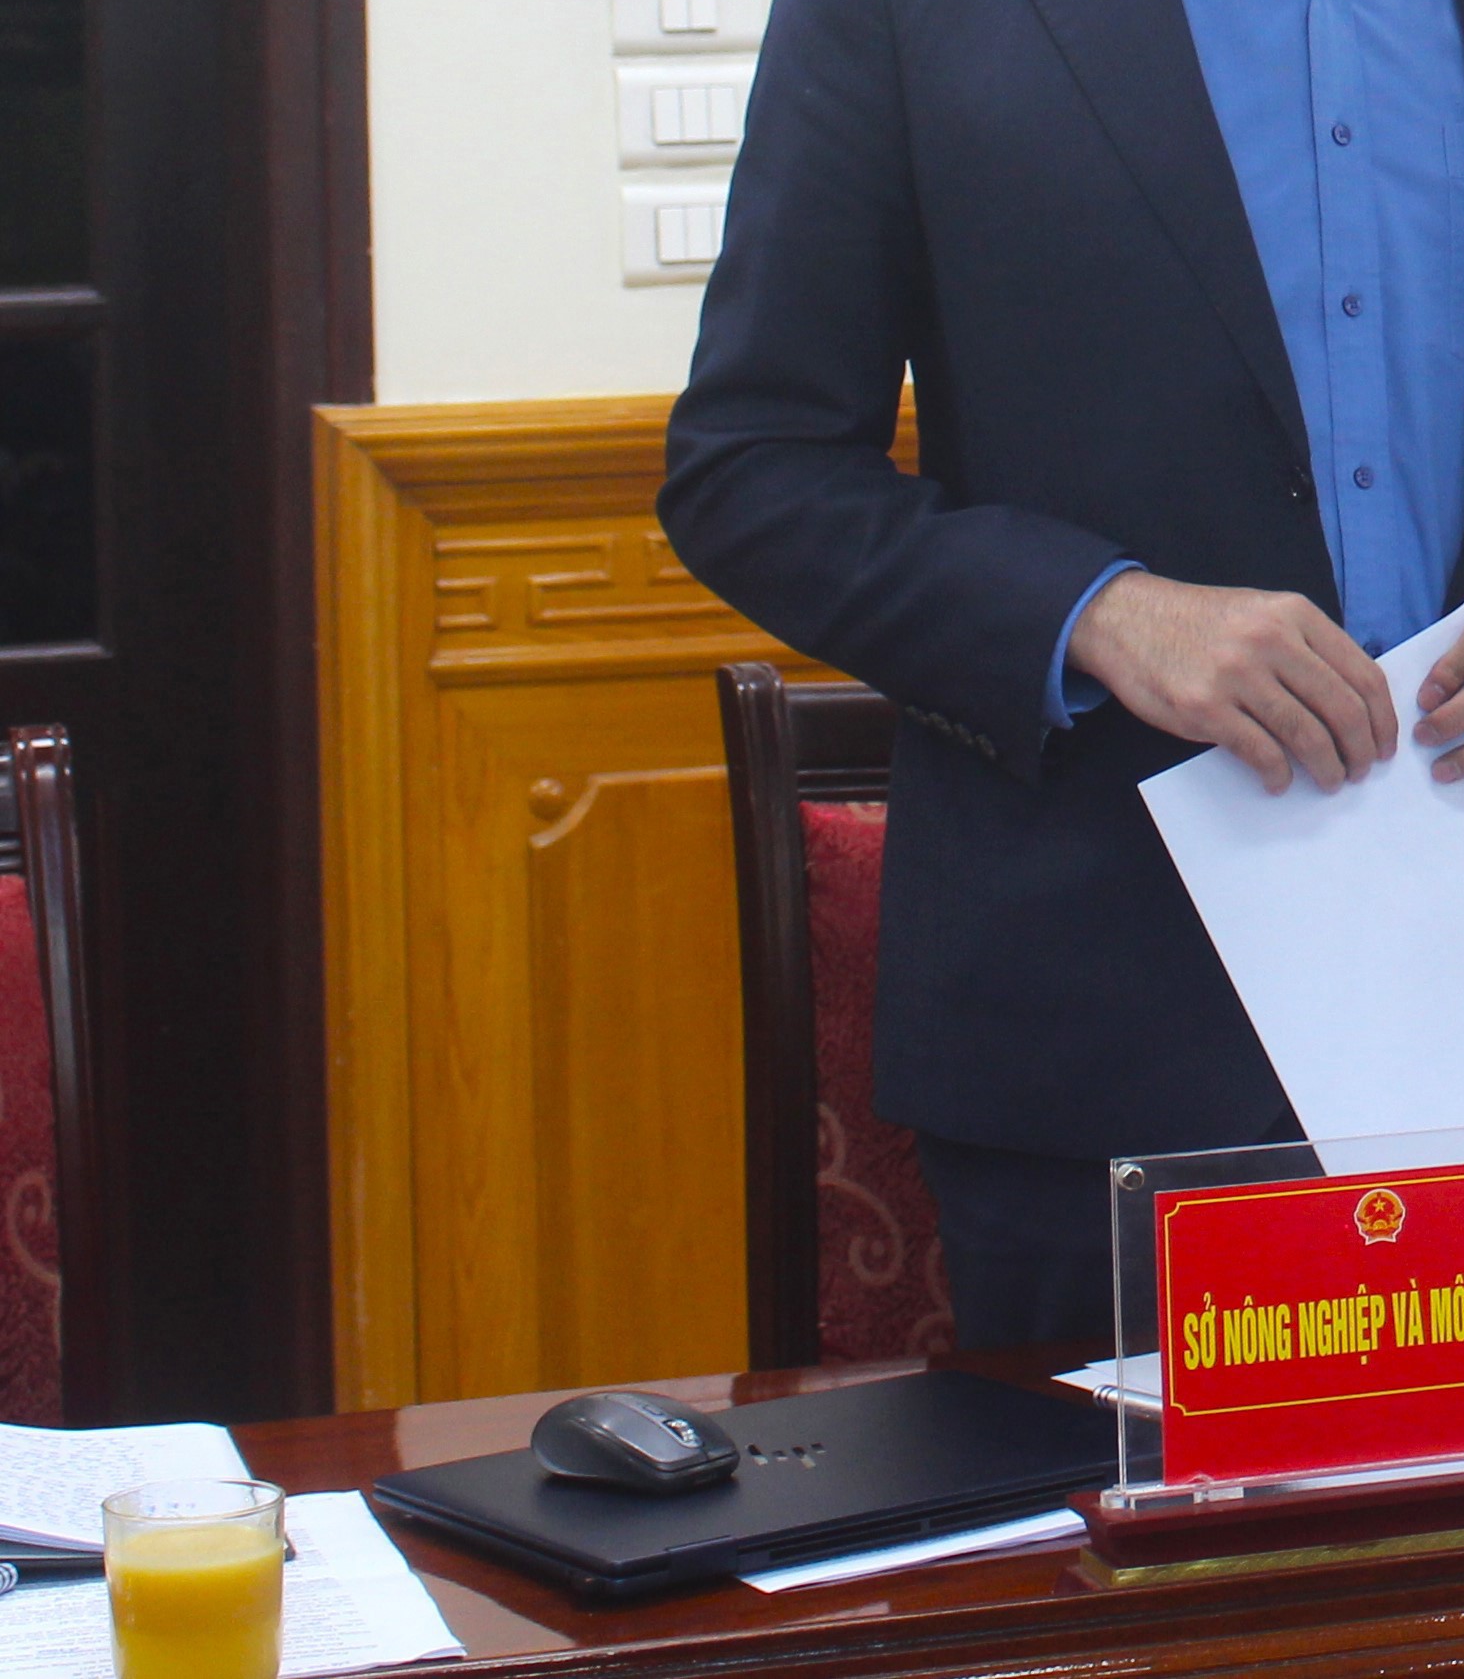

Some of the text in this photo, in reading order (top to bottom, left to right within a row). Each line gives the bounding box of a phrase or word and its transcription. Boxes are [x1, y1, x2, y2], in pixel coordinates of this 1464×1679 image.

[1183, 1291, 1217, 1370] SỞ
[1224, 1293, 1291, 1366] NÔNG
[1298, 1285, 1385, 1365] NGHIỆP
[1392, 1278, 1424, 1347] VÀ
